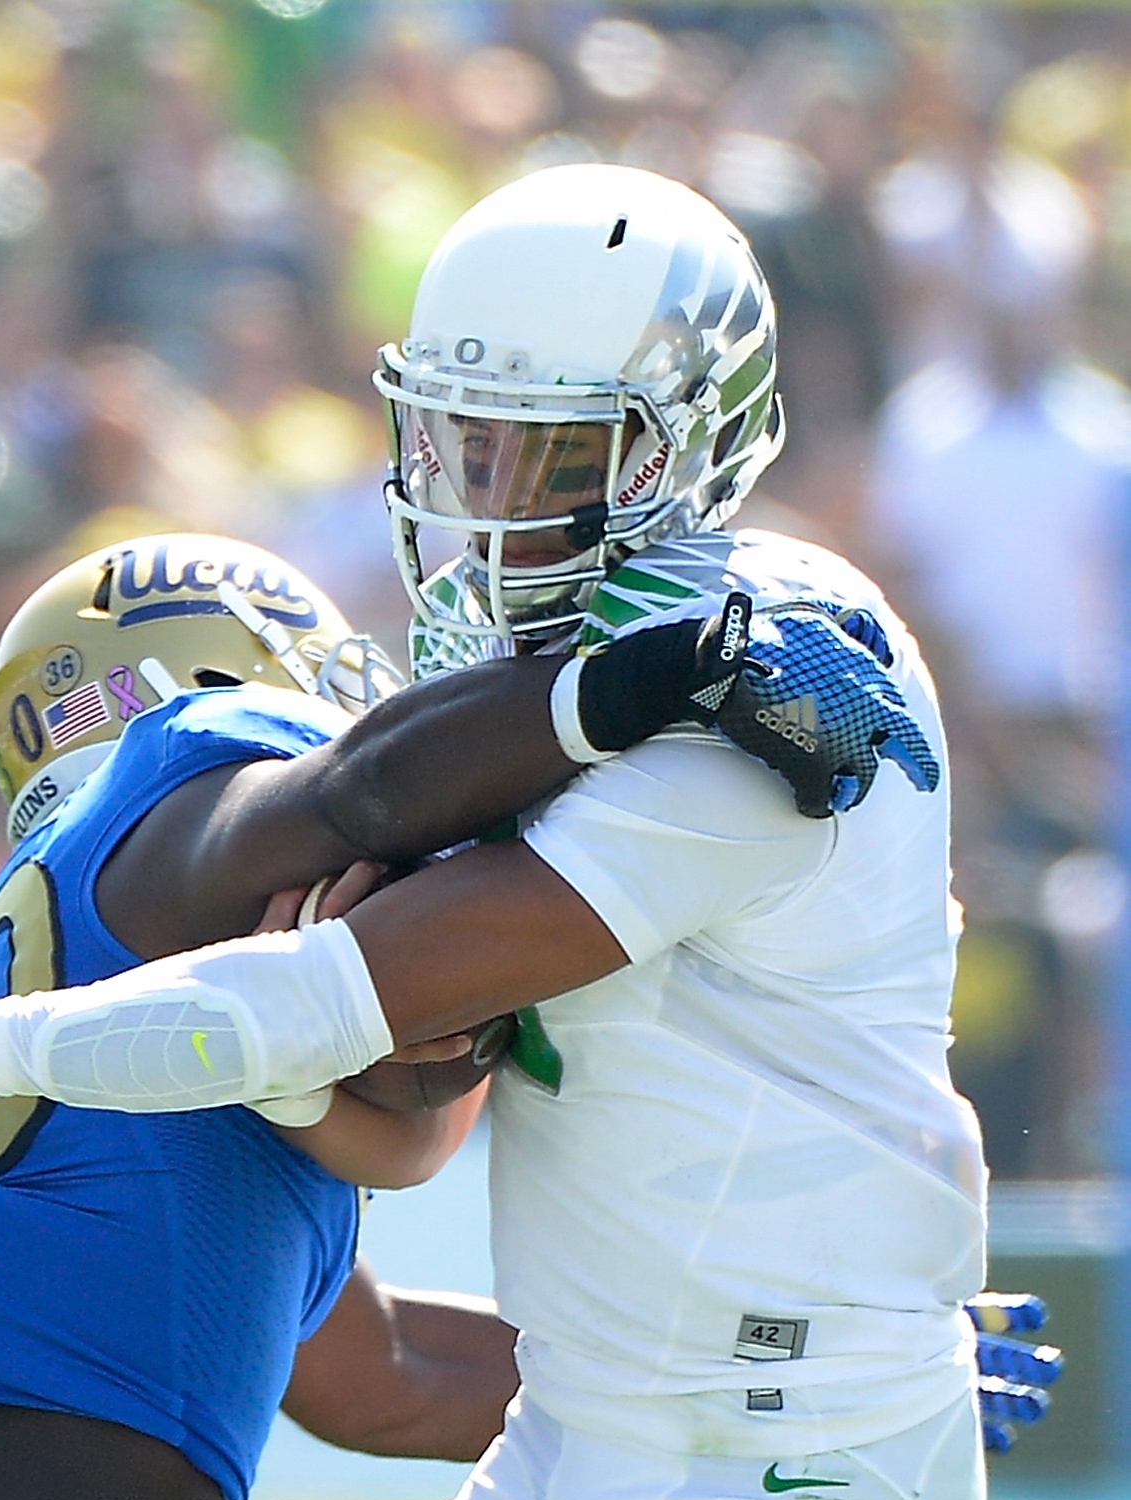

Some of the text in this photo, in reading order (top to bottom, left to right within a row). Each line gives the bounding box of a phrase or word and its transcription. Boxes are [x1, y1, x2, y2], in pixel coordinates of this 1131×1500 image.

[46, 654, 74, 687] 36
[755, 708, 818, 754] adidas
[751, 1325, 779, 1343] 42
